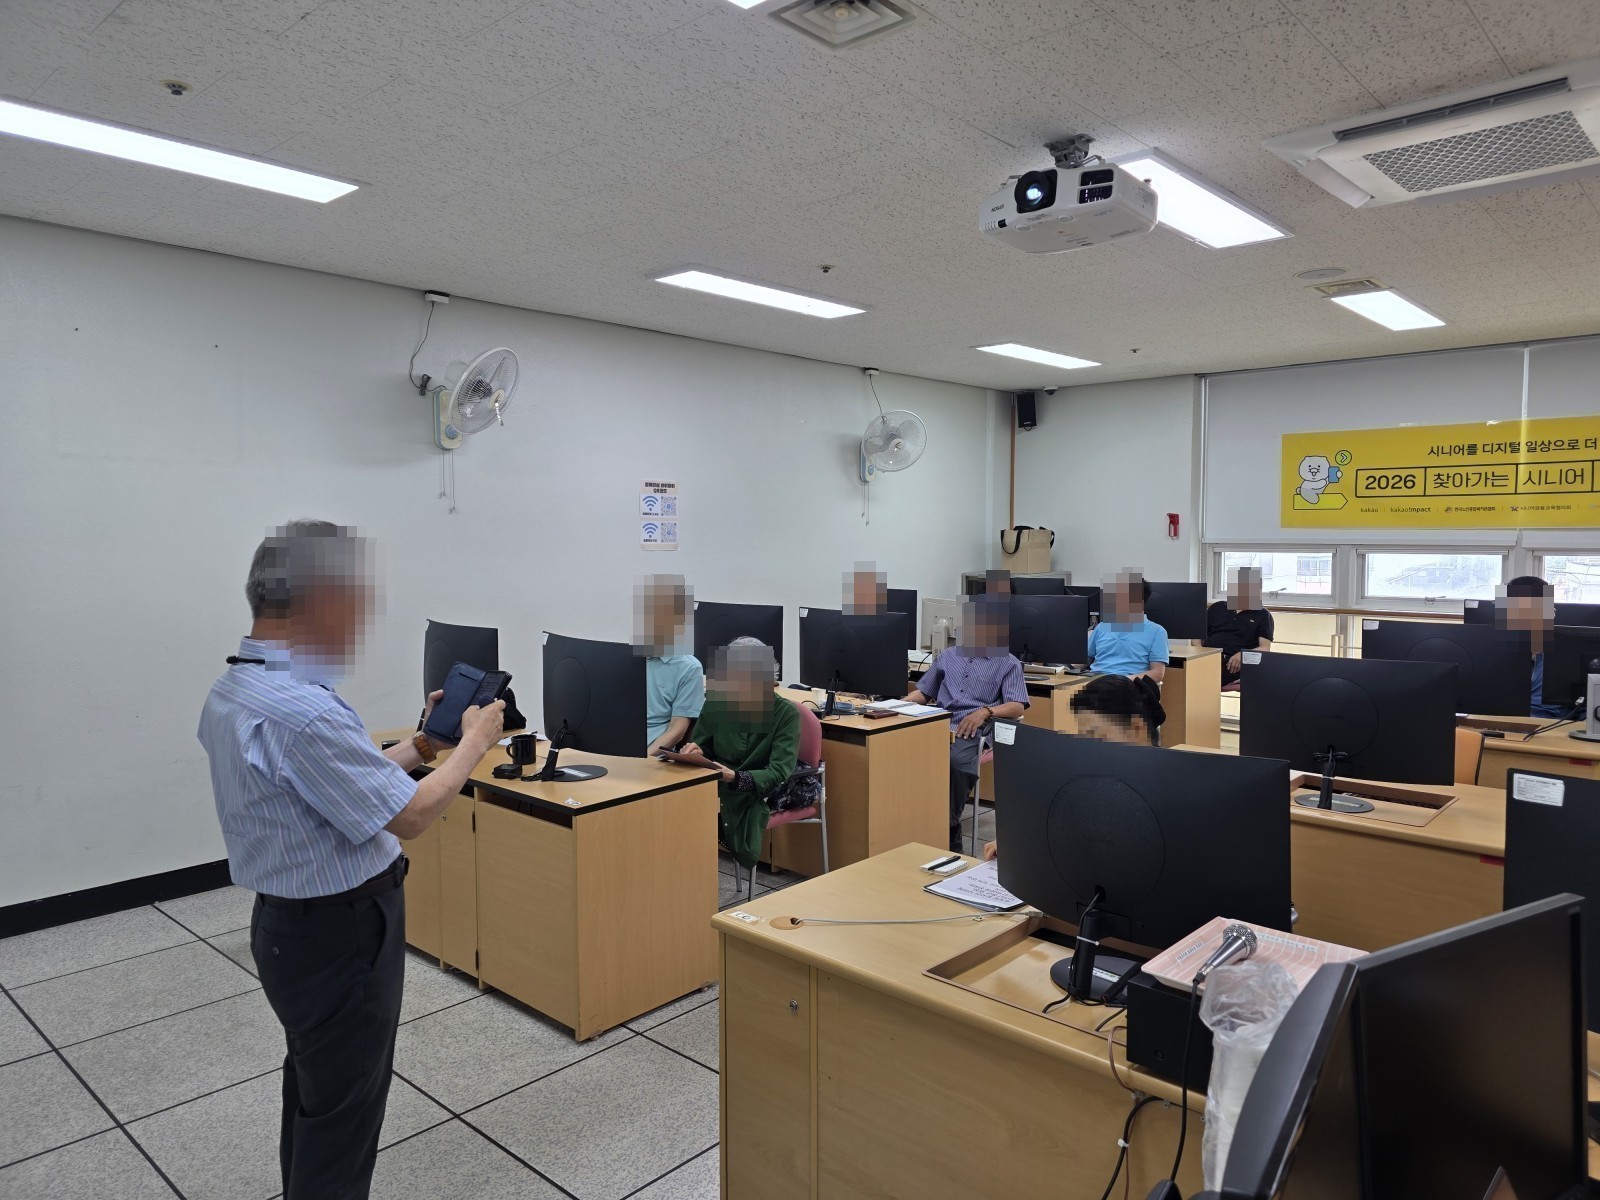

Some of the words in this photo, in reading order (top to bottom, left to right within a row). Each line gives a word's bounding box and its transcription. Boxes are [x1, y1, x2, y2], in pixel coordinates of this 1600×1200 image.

[1427, 443, 1479, 456] 시니어를
[1482, 441, 1521, 454] 디지털
[1525, 439, 1580, 453] 일상으로
[1584, 438, 1598, 450] 더
[1365, 474, 1417, 490] 2026
[1433, 471, 1509, 489] 찾아가는
[1522, 468, 1585, 486] 시니어
